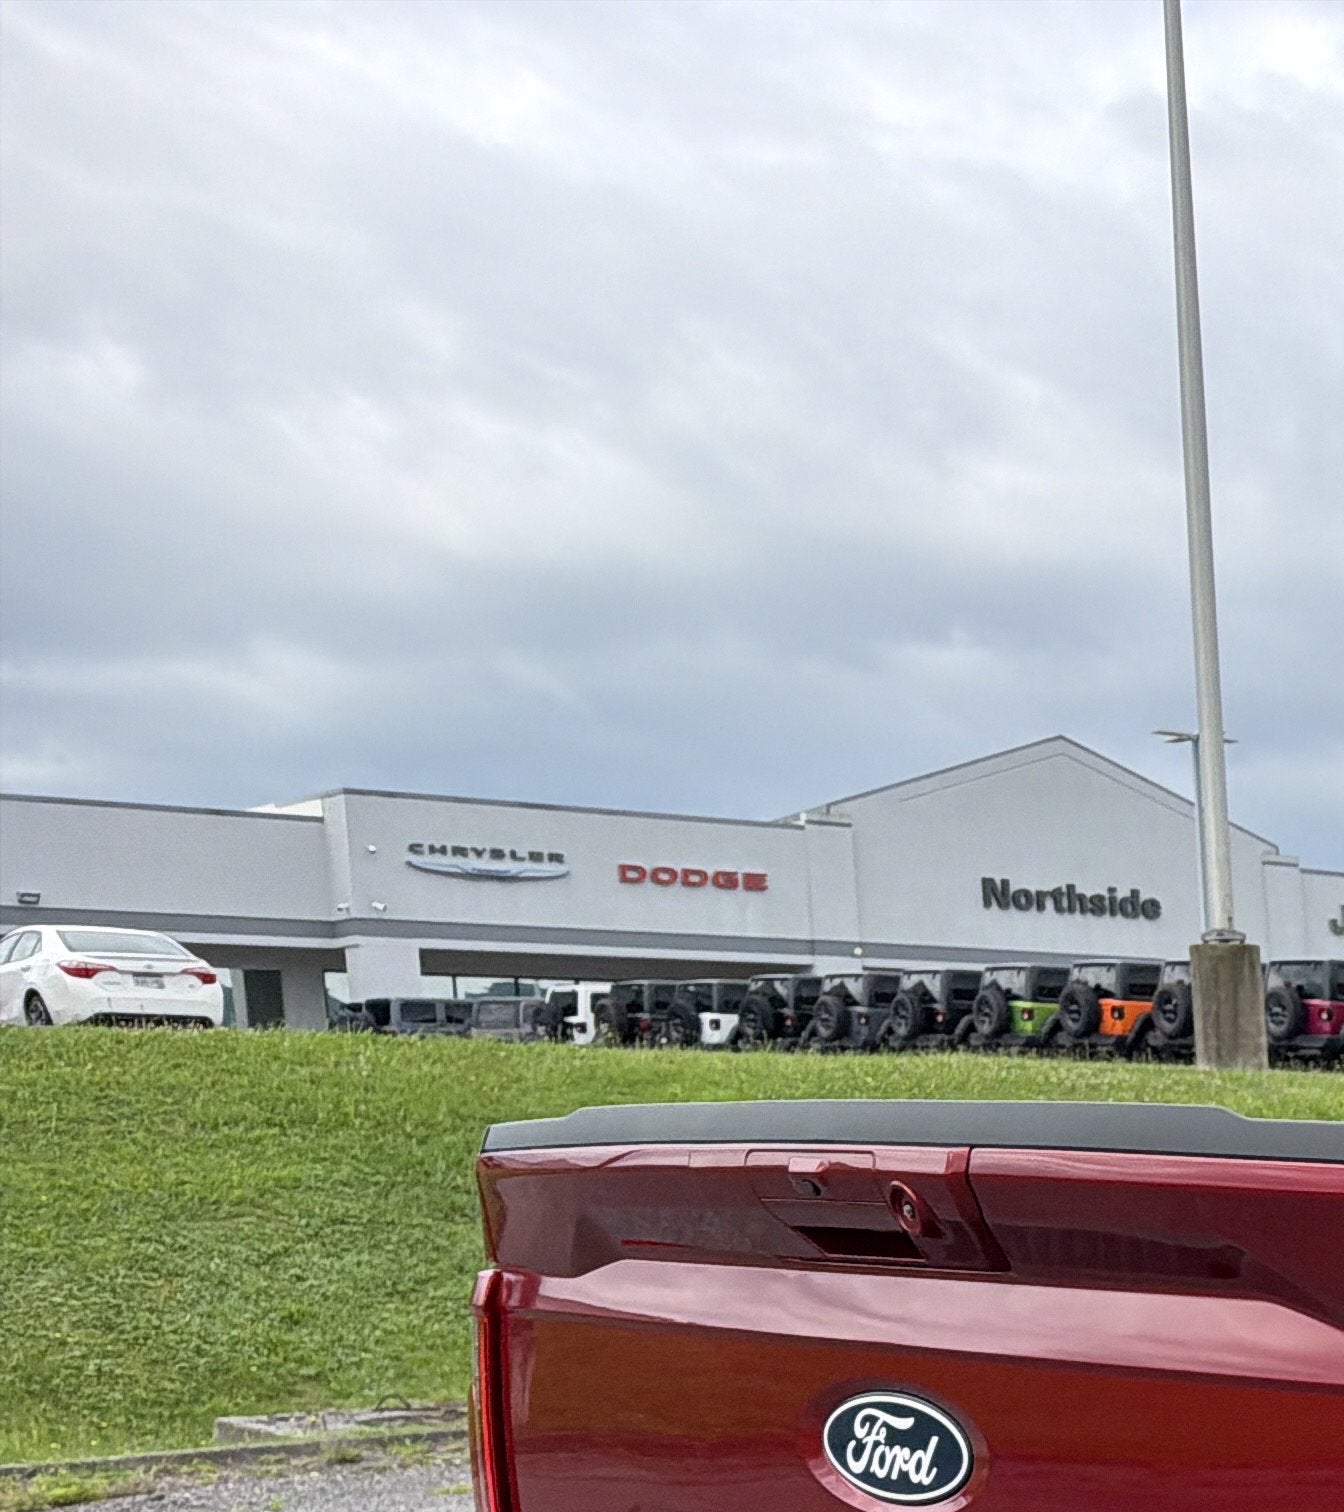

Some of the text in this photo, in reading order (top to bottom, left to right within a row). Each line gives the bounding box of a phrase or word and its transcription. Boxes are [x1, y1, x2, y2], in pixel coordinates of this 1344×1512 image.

[407, 843, 564, 864] CHRYSLER
[619, 864, 768, 892] DODGE
[981, 877, 1162, 920] Northside
[846, 1407, 940, 1486] Ford
